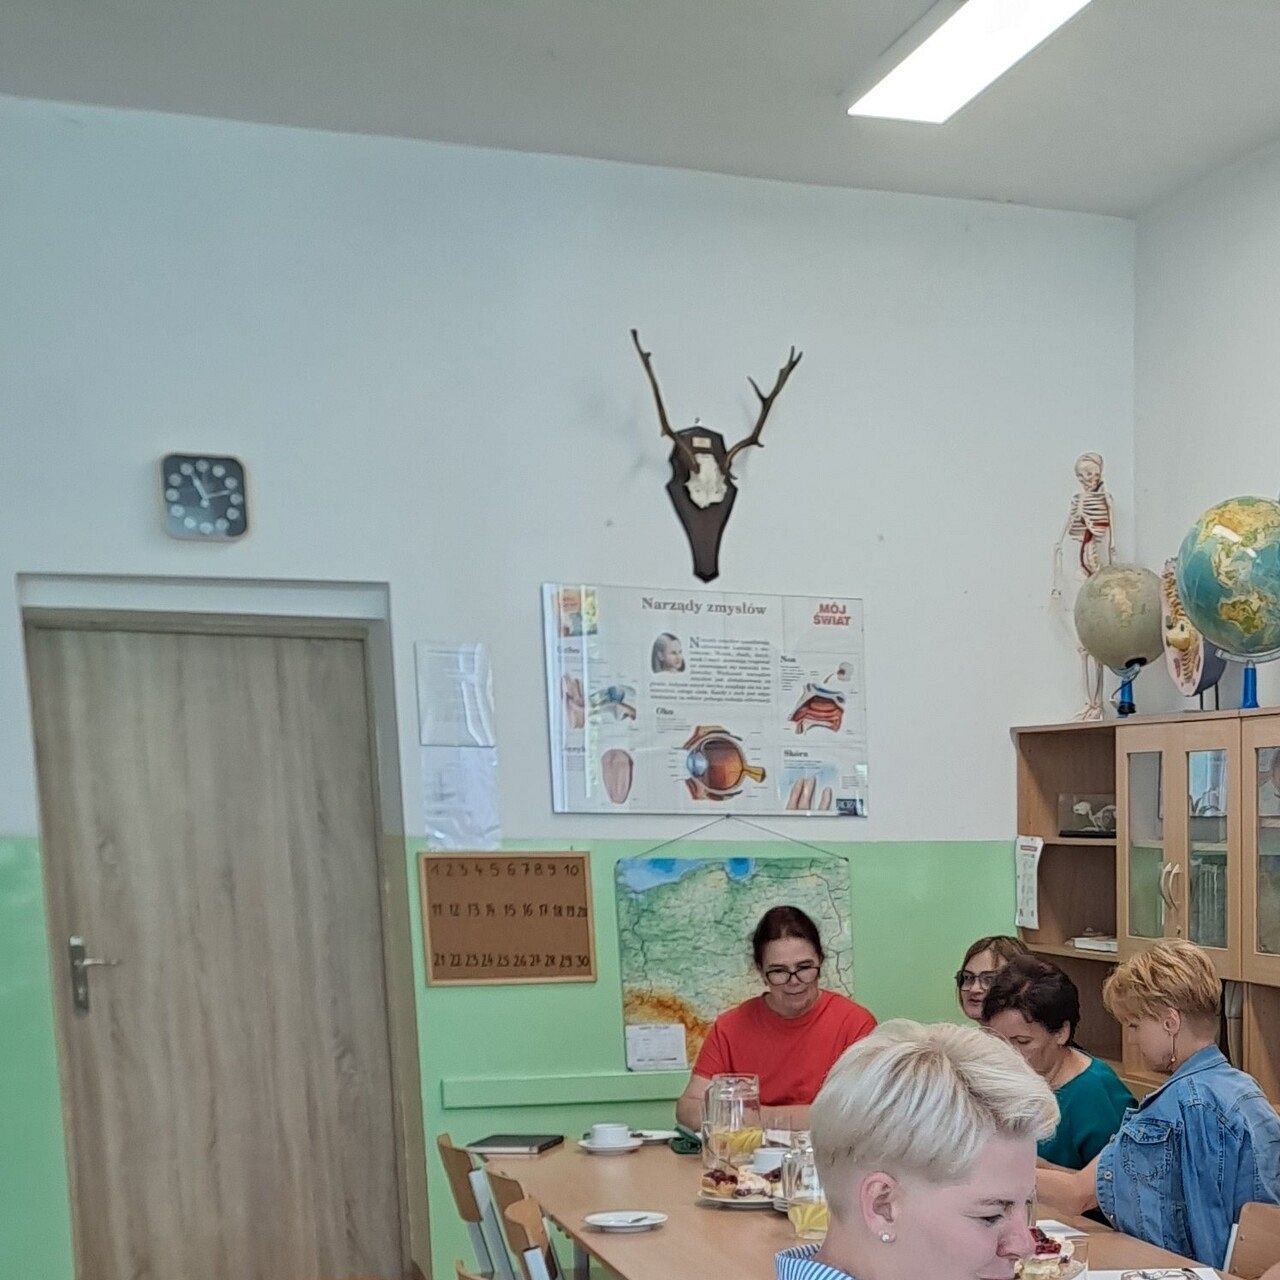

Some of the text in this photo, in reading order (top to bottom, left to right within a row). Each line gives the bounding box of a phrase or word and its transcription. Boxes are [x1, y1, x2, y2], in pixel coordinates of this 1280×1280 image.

[642, 597, 703, 615] Narządy
[819, 602, 846, 615] MÓJ
[813, 612, 851, 627] ŚWIAT
[431, 864, 439, 876] 1
[446, 863, 454, 877] 2
[459, 863, 468, 877] 3
[489, 863, 500, 877] 5
[507, 863, 517, 876] 6
[521, 863, 530, 876] 7
[534, 863, 543, 876] 8
[547, 863, 556, 876] 9
[564, 863, 579, 877] 10
[431, 903, 442, 916] 11
[449, 903, 460, 917] 12
[468, 903, 480, 917] 13
[486, 903, 495, 917] 14
[504, 903, 516, 917] 15
[522, 903, 533, 917] 16
[538, 903, 548, 917] 17
[434, 953, 590, 968] 21 22 23 24 25 26 27 28 29 30
